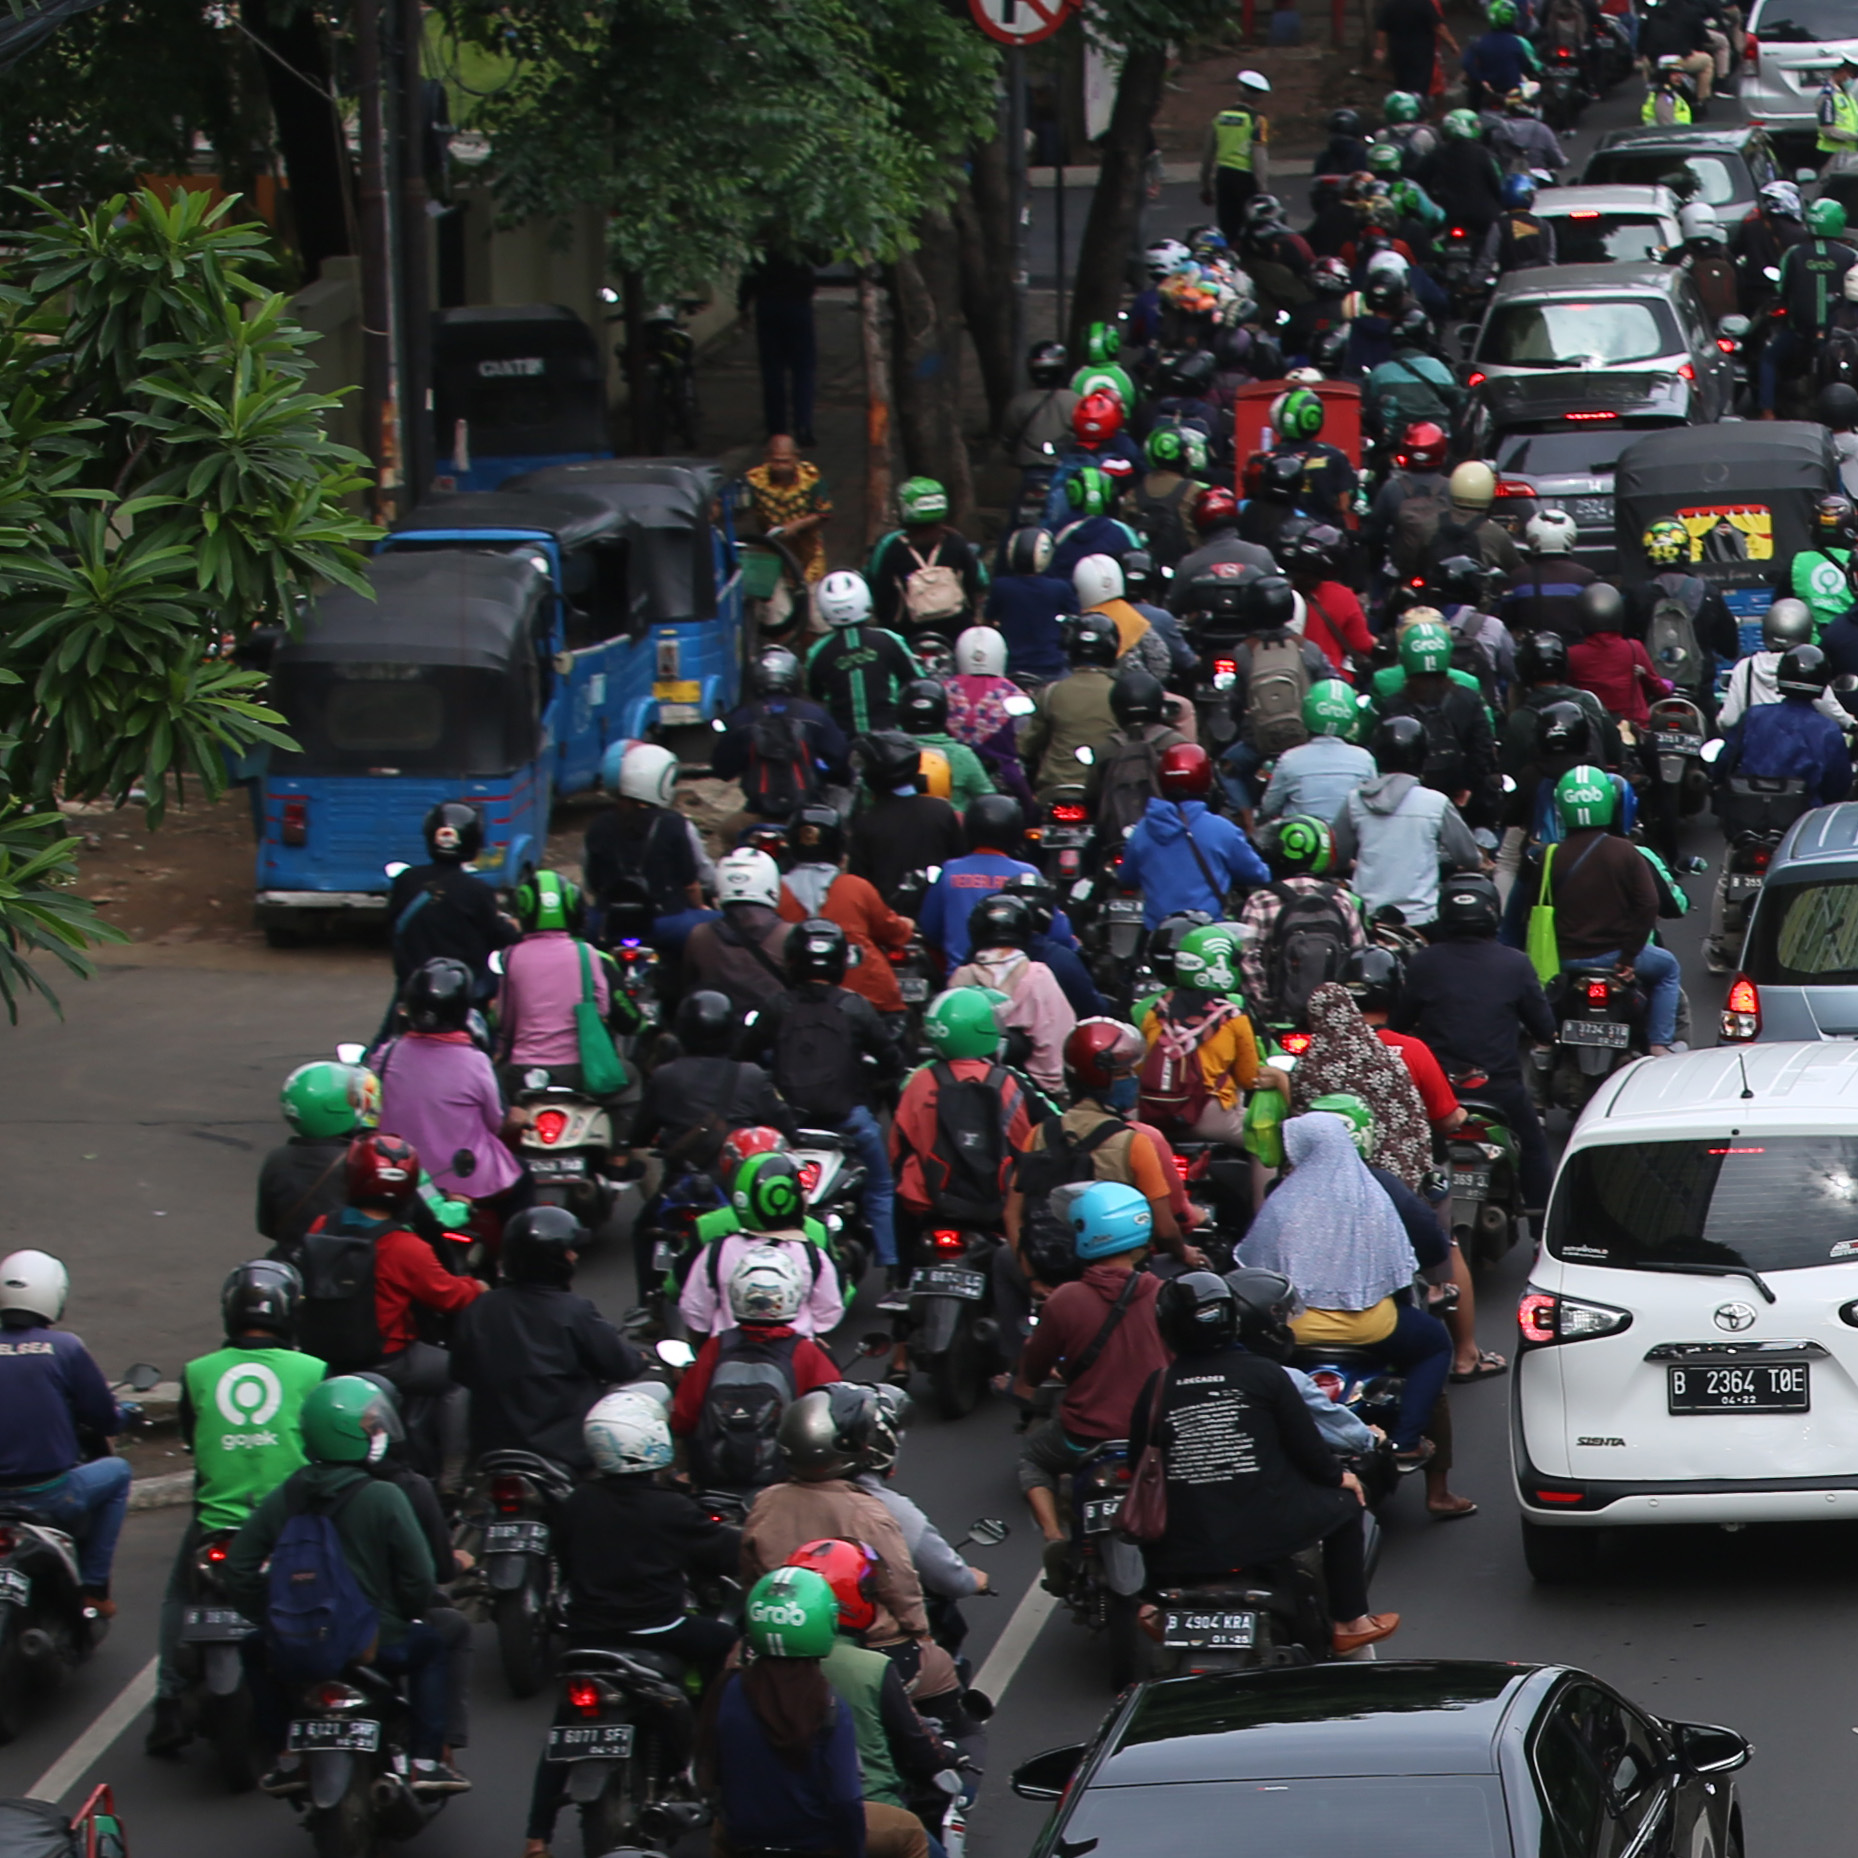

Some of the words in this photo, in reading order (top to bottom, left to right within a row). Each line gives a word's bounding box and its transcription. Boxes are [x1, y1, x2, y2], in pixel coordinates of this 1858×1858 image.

[1411, 638, 1447, 653] Grab
[1316, 701, 1354, 719] Grab
[1564, 787, 1604, 803] Grab
[1673, 1370, 1686, 1395] B
[1706, 1369, 1755, 1395] 2364
[221, 1430, 279, 1451] gojek
[1576, 1436, 1626, 1447] SIENTA
[750, 1600, 807, 1627] Grab
[1185, 1615, 1220, 1630] 4904
[1222, 1615, 1251, 1629] KRA
